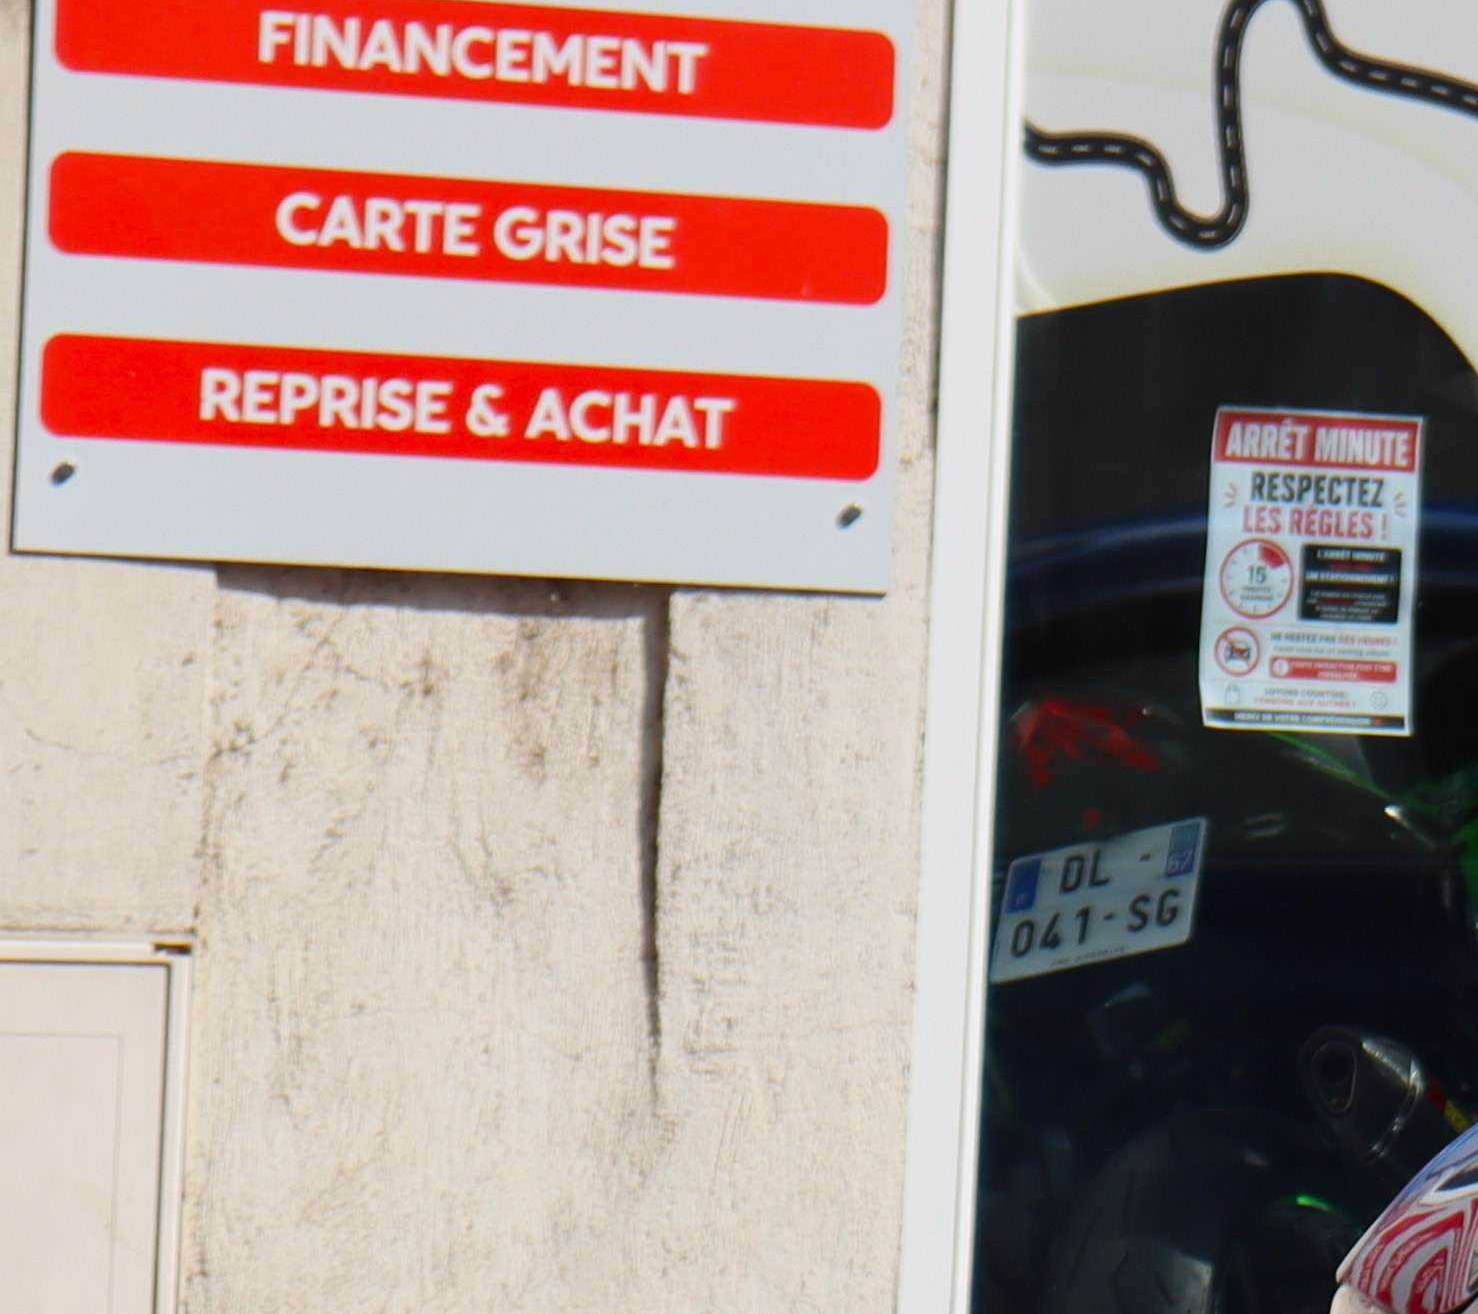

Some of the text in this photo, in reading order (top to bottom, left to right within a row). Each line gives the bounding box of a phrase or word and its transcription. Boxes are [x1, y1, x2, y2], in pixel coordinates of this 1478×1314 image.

[258, 10, 710, 96] FINANCEMENT
[275, 192, 677, 269] CARTE GRISE
[200, 368, 736, 451] REPRISE & ACHAT
[1225, 417, 1409, 467] ARRÊT MINUTE
[1251, 471, 1384, 508] RESPECTEZ
[1242, 506, 1281, 534] LES
[1247, 564, 1267, 584] 15
[1059, 847, 1109, 894] DL
[1168, 849, 1195, 871] 67
